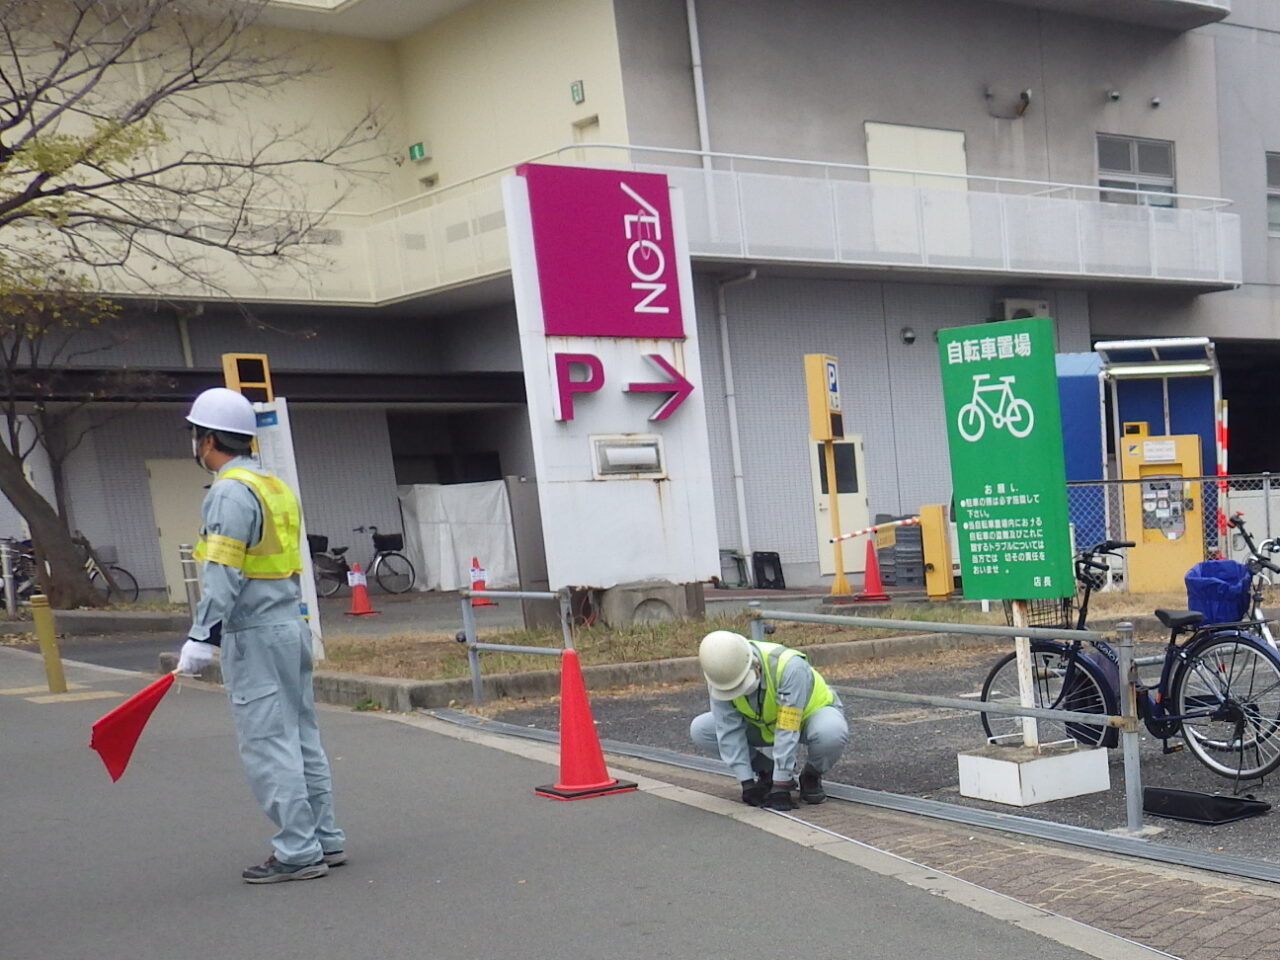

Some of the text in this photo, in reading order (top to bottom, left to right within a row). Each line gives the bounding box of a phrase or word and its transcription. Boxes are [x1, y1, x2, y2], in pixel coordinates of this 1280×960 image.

[620, 182, 669, 313] AEON
[947, 333, 1031, 364] 自転車置場
[555, 353, 605, 421] P
